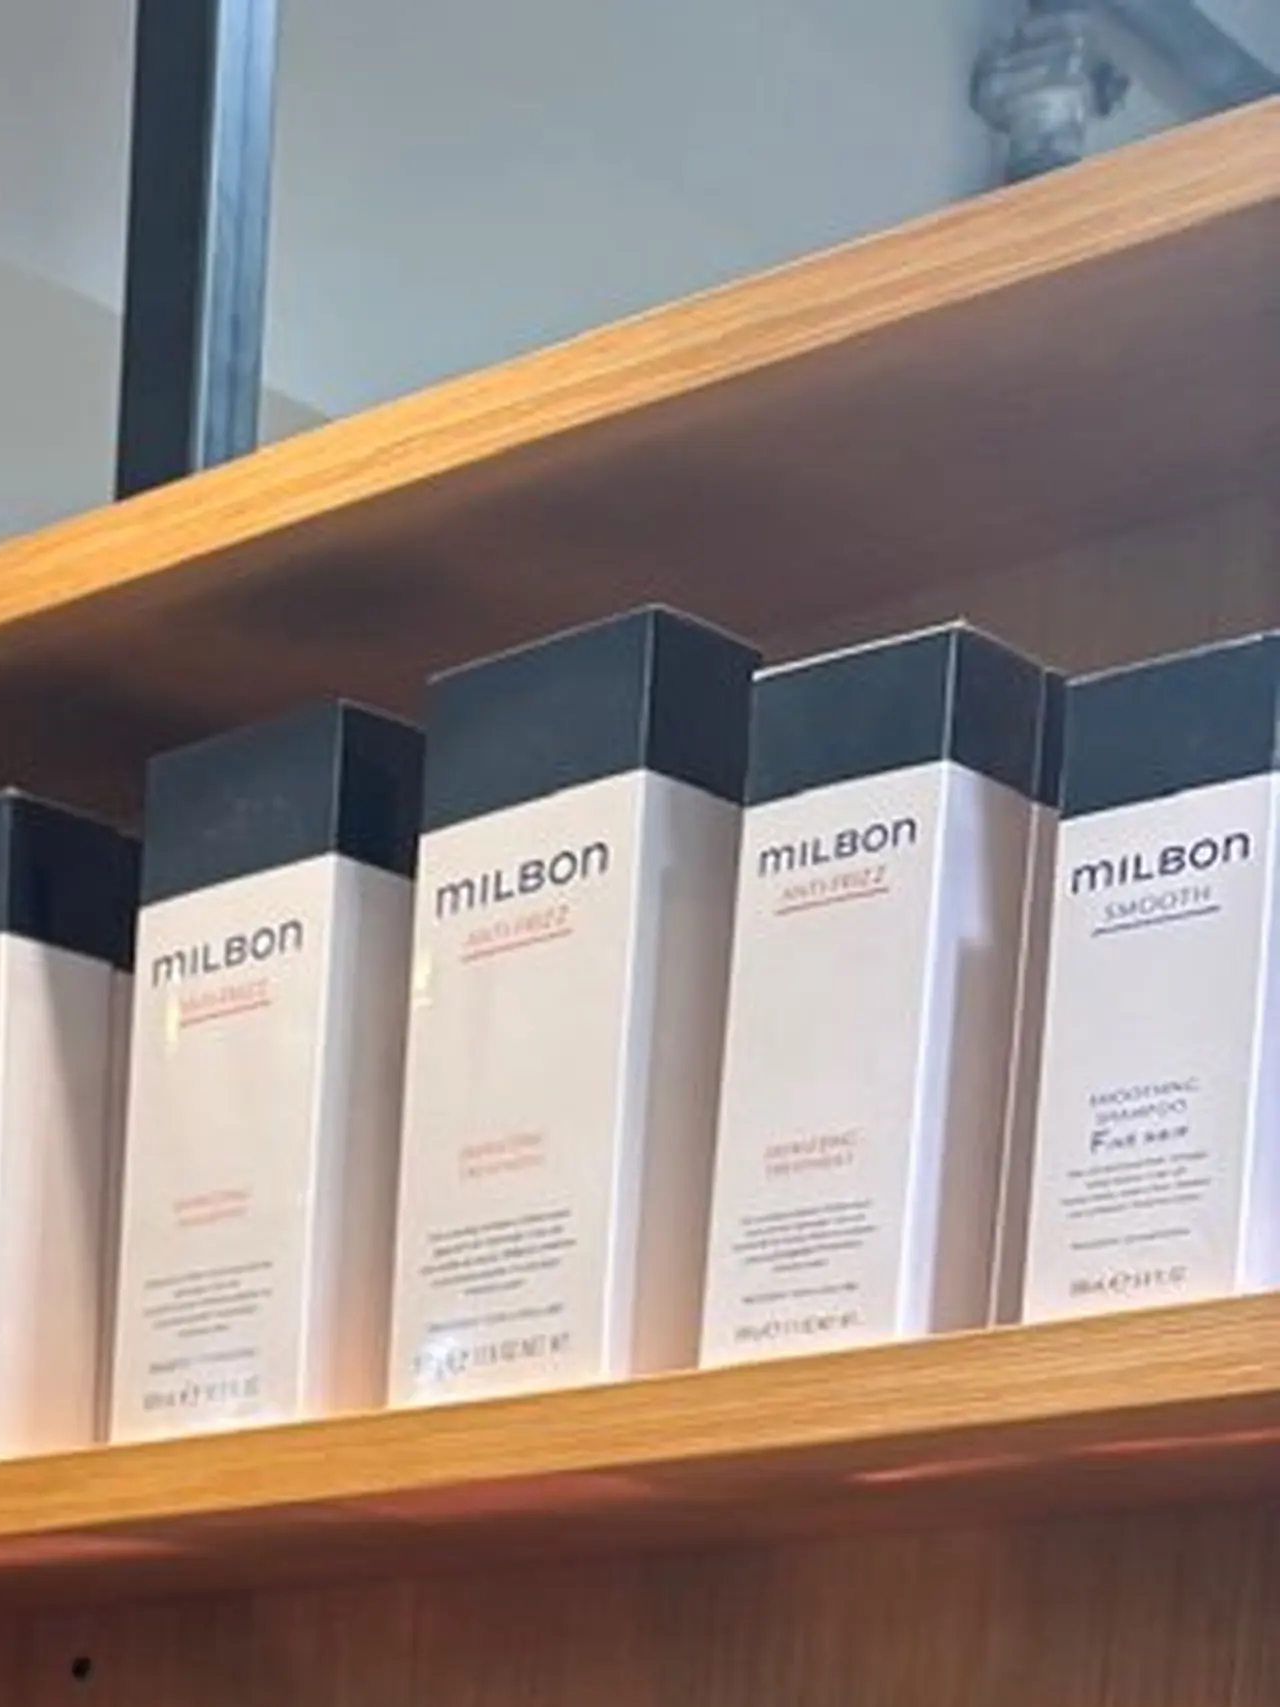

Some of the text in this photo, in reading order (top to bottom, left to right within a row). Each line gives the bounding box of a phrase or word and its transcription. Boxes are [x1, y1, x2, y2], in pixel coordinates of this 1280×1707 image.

[759, 817, 917, 878] MILBON
[1072, 832, 1250, 895] MILBON
[436, 841, 610, 918] MILBON
[1103, 885, 1212, 920] SMOOTH
[152, 918, 305, 988] MILBON
